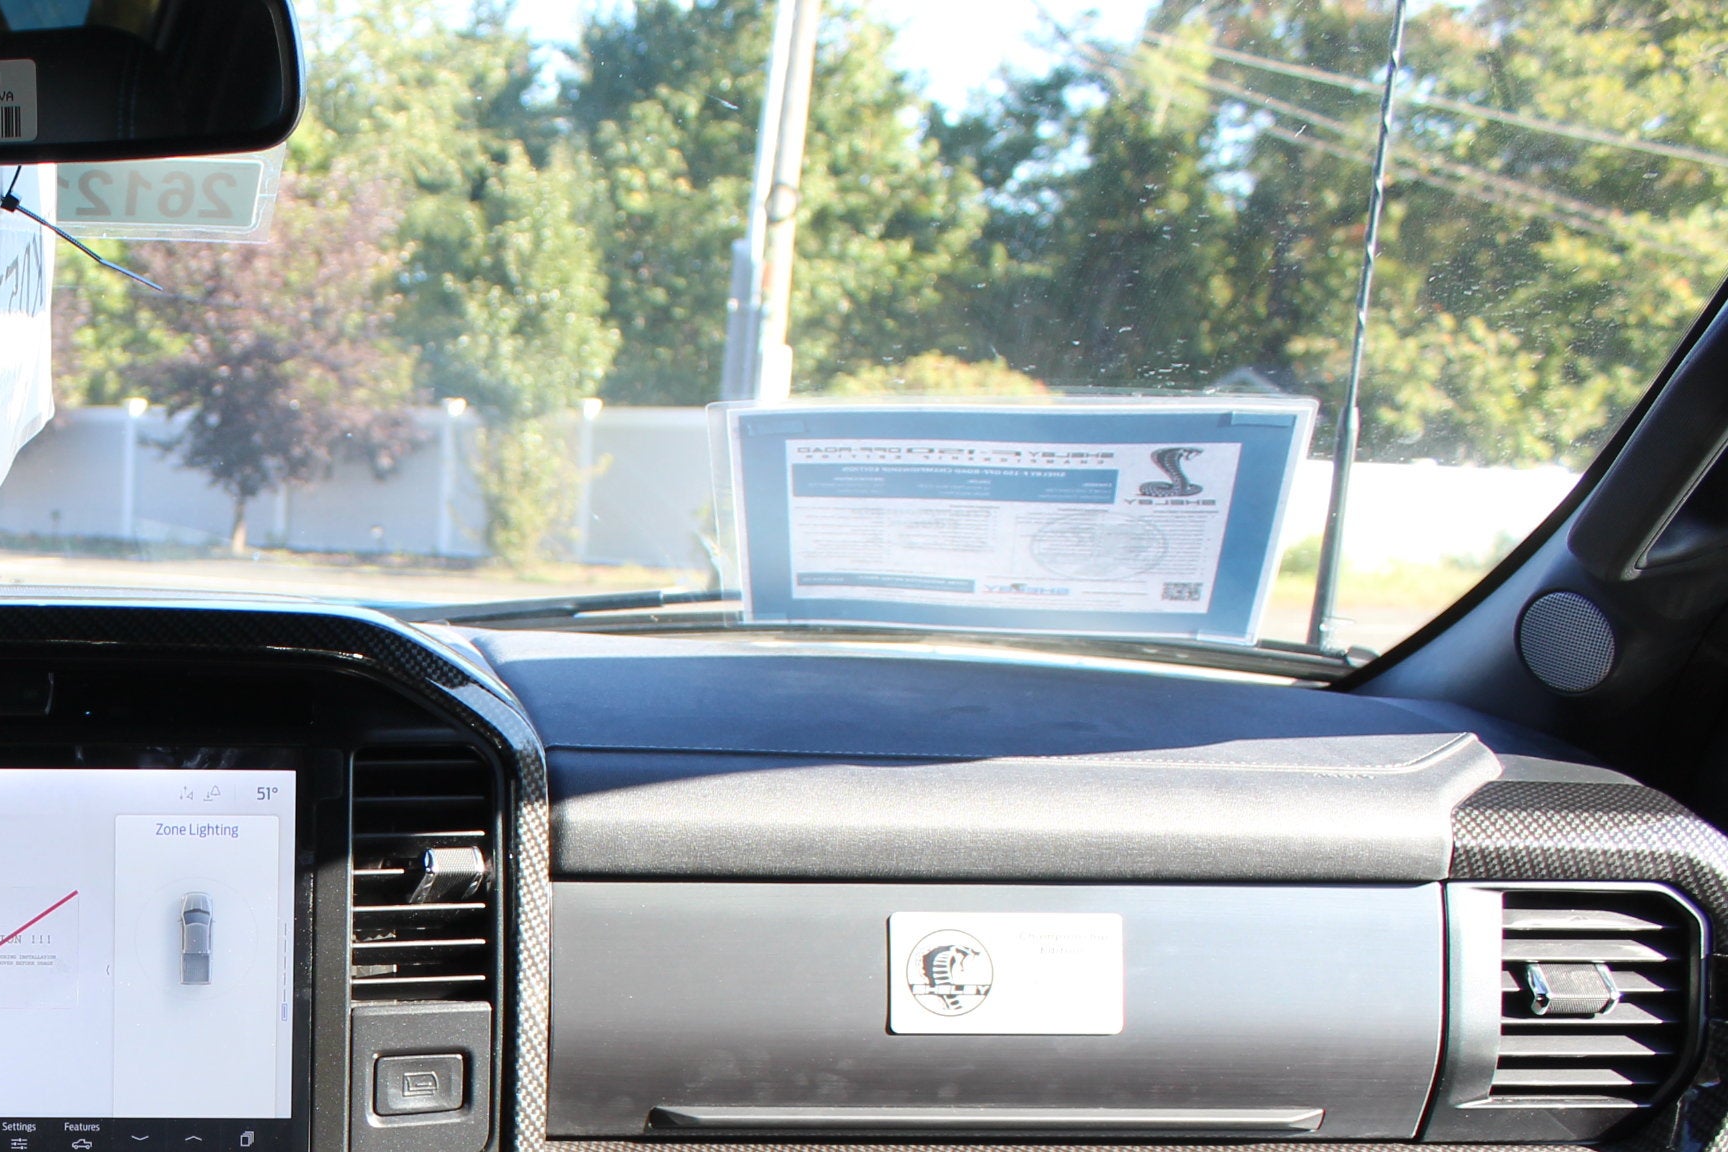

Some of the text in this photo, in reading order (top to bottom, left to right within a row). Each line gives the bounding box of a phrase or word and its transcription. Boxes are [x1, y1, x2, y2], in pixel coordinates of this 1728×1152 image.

[155, 822, 239, 838] Zone Lighting
[2, 1122, 37, 1132] Settings
[64, 1122, 100, 1132] Features
